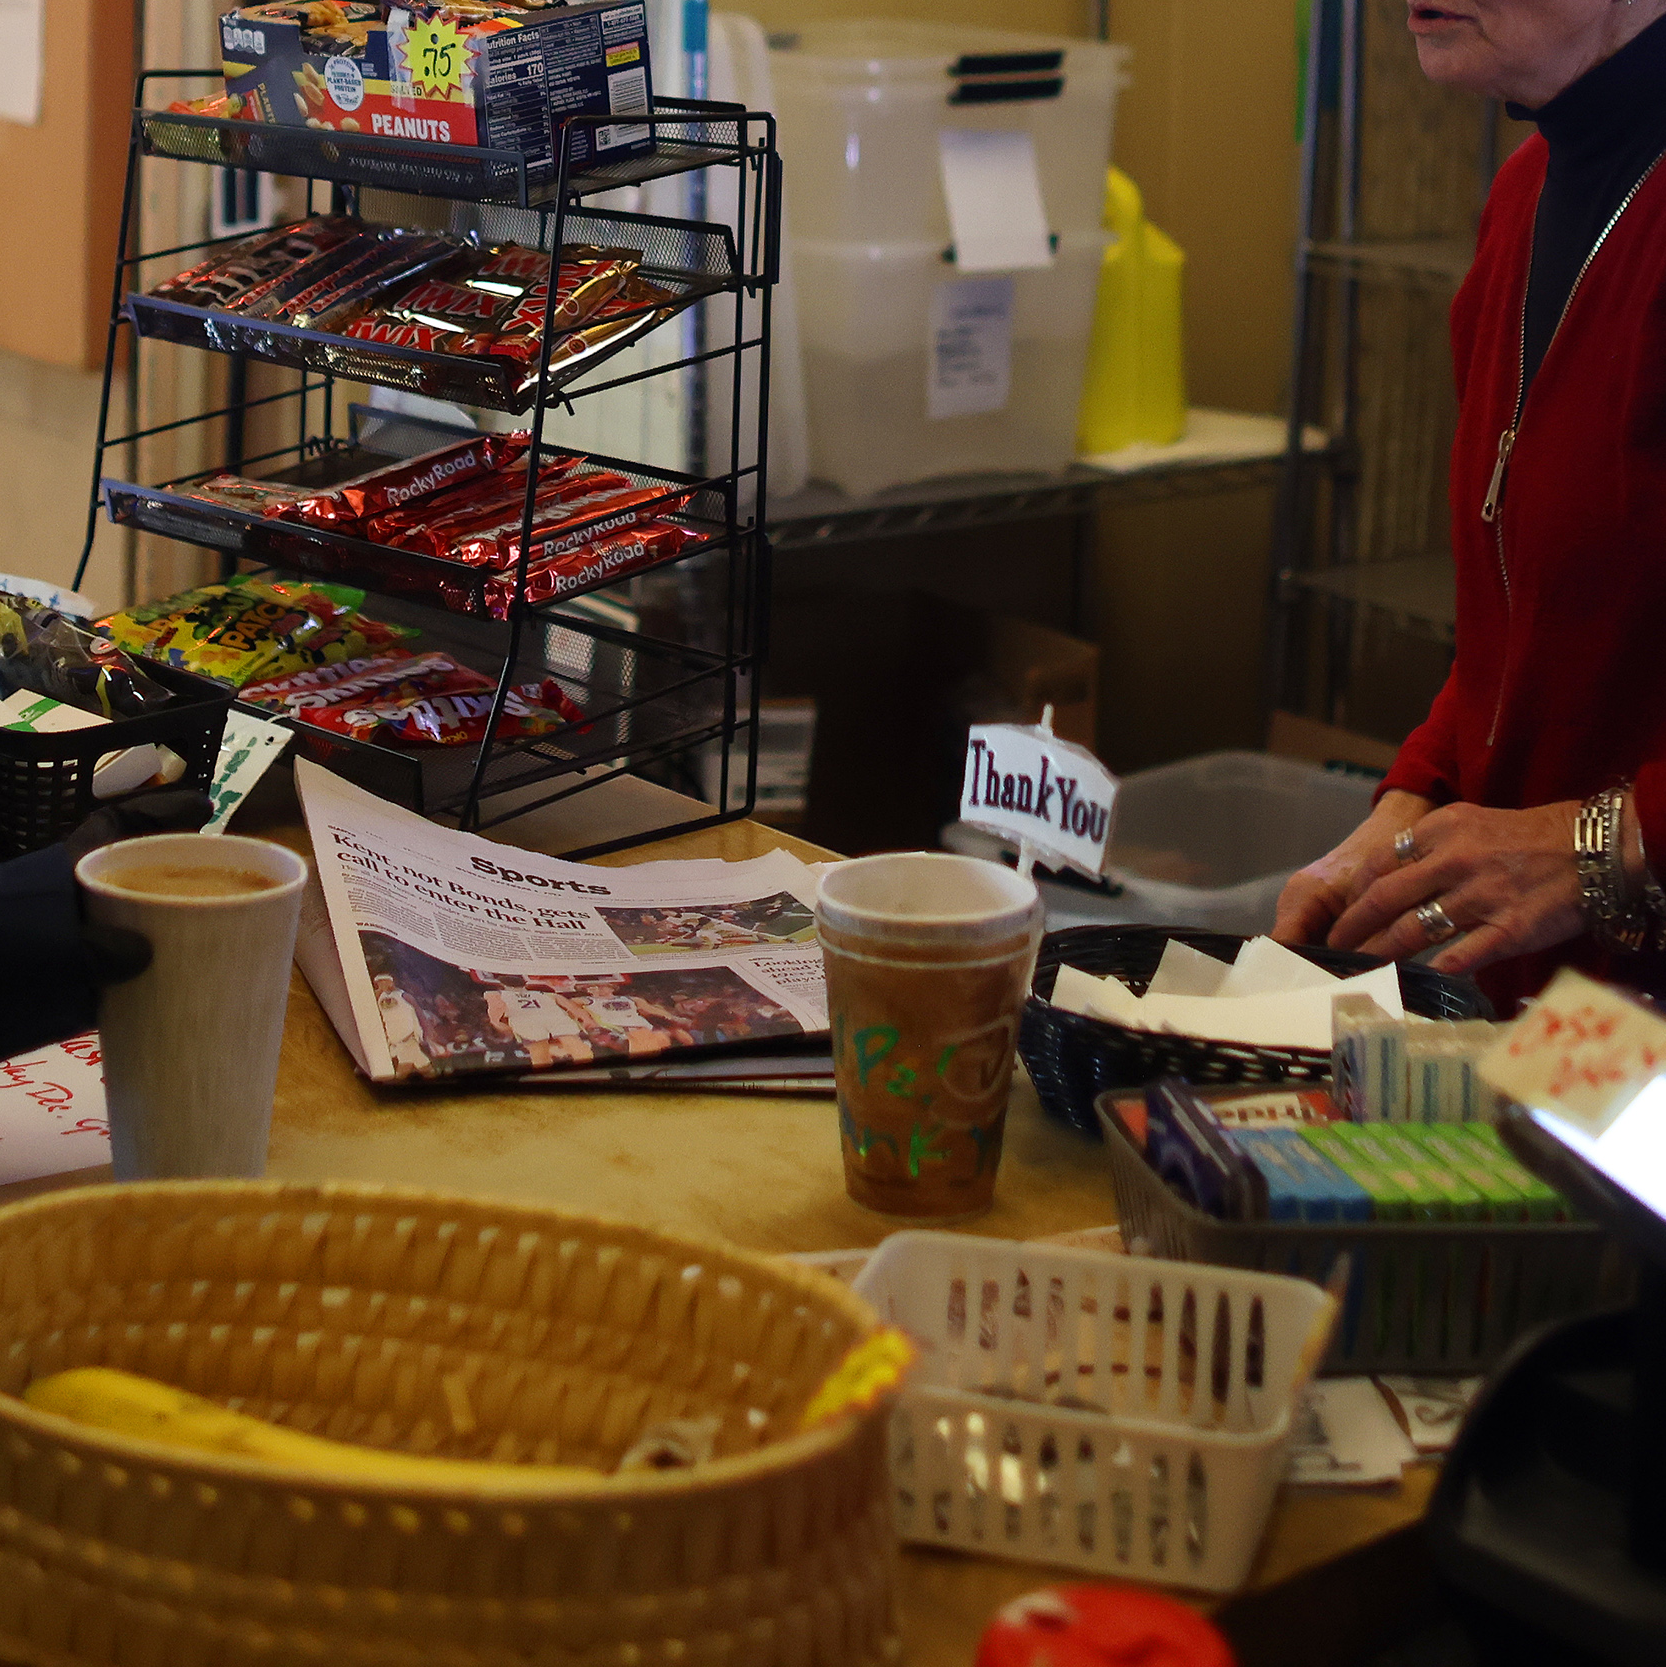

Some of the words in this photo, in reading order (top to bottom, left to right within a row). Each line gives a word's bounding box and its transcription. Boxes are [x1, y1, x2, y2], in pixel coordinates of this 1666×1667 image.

[486, 33, 517, 50] utrition
[488, 71, 517, 85] alories
[526, 62, 544, 76] 170
[371, 113, 451, 144] PEANUTS
[393, 281, 503, 319] TWIX
[332, 832, 399, 871] Kent,
[402, 864, 444, 889] not
[447, 880, 534, 915] Bonds,
[535, 905, 592, 922] gets
[336, 851, 380, 874] call
[385, 868, 410, 887] to
[413, 883, 481, 916] enter
[484, 907, 528, 927] the
[533, 917, 588, 931] Hall
[469, 856, 612, 896] Sports
